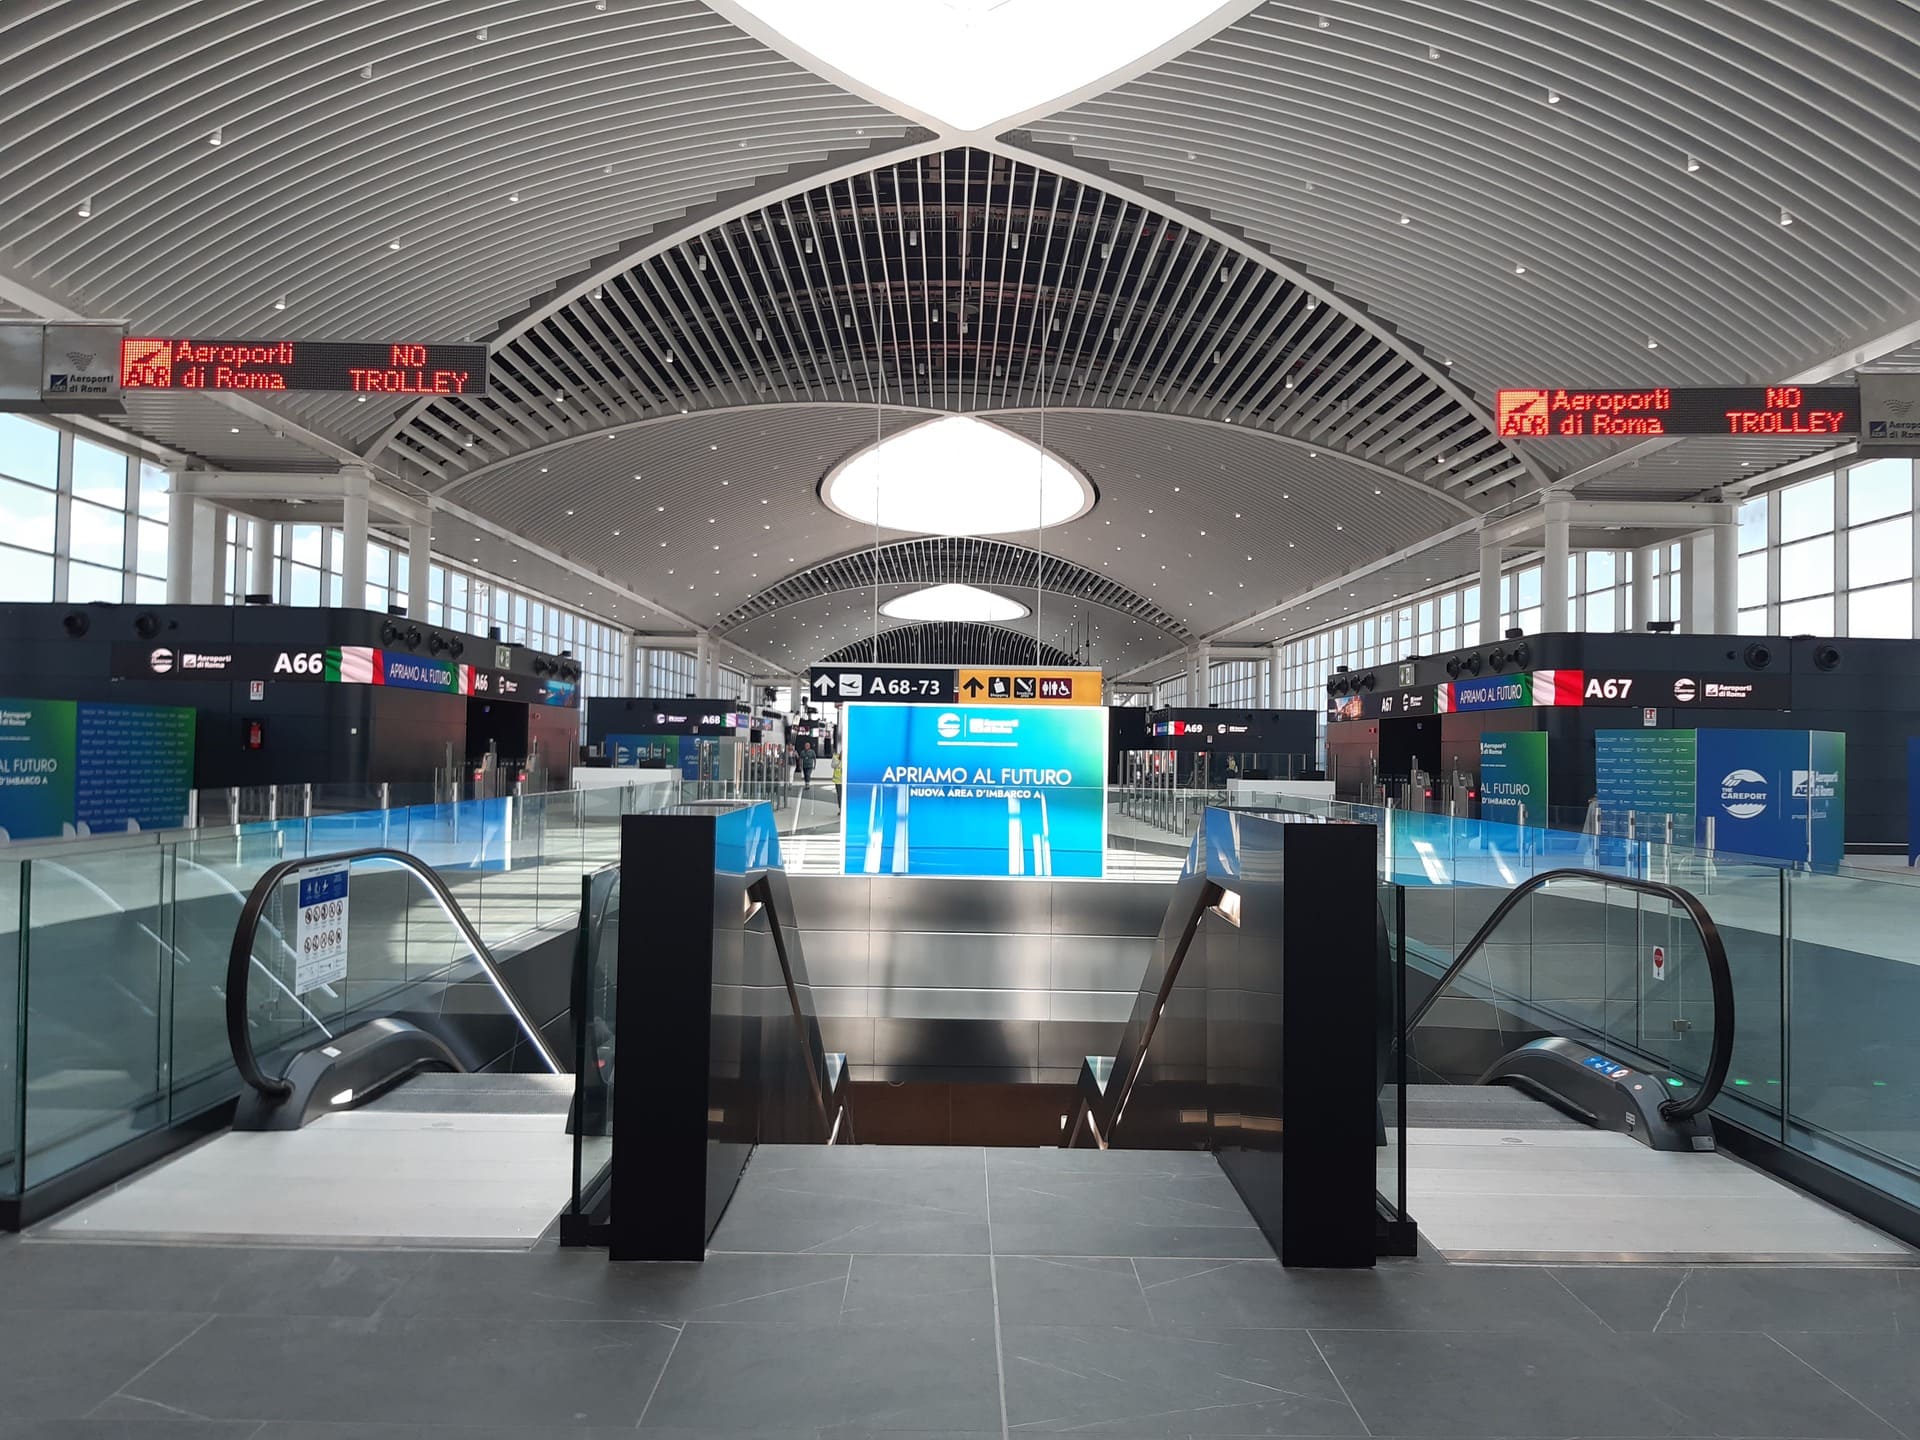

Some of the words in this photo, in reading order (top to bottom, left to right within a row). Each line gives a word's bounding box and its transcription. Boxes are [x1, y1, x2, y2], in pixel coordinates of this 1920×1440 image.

[176, 340, 294, 368] Aeroporti
[392, 344, 426, 367] NO
[70, 374, 114, 384] Aeroporti
[183, 367, 205, 388] di
[217, 367, 287, 390] Roma
[350, 369, 468, 393] TROLLEY
[1552, 389, 1671, 415] Aeroporti
[1766, 387, 1802, 409] NO
[1559, 414, 1583, 435] di
[1593, 414, 1664, 435] Roma
[1725, 412, 1844, 433] TROLLEY
[197, 654, 232, 662] Aeroporti
[274, 653, 323, 673] A66
[390, 663, 418, 681] APRIAMO
[421, 668, 428, 682] AL
[429, 668, 451, 685] FUTURO
[475, 673, 488, 692] A66
[1460, 688, 1486, 704] APRIAMO
[1488, 688, 1496, 702] AL
[1497, 684, 1522, 700] FUTURO
[1585, 679, 1632, 699] A67
[1719, 684, 1752, 692] Aeroporti
[1381, 697, 1393, 712] A67
[702, 715, 720, 724] A68
[1184, 724, 1203, 733] A69
[13, 759, 58, 773] FUTURO
[42, 776, 48, 785] A
[882, 767, 967, 784] APRIAMO
[973, 768, 995, 784] AL
[1001, 768, 1072, 786] FUTURO
[910, 788, 945, 797] NUOVA
[948, 788, 973, 798] AREA
[976, 789, 1031, 799] D'IMBARCO
[1034, 790, 1041, 799] A
[1480, 783, 1491, 794] AL
[1493, 783, 1530, 796] FUTURO
[1721, 792, 1768, 800] CAREPORT
[1481, 797, 1516, 806] D'IMBARCO
